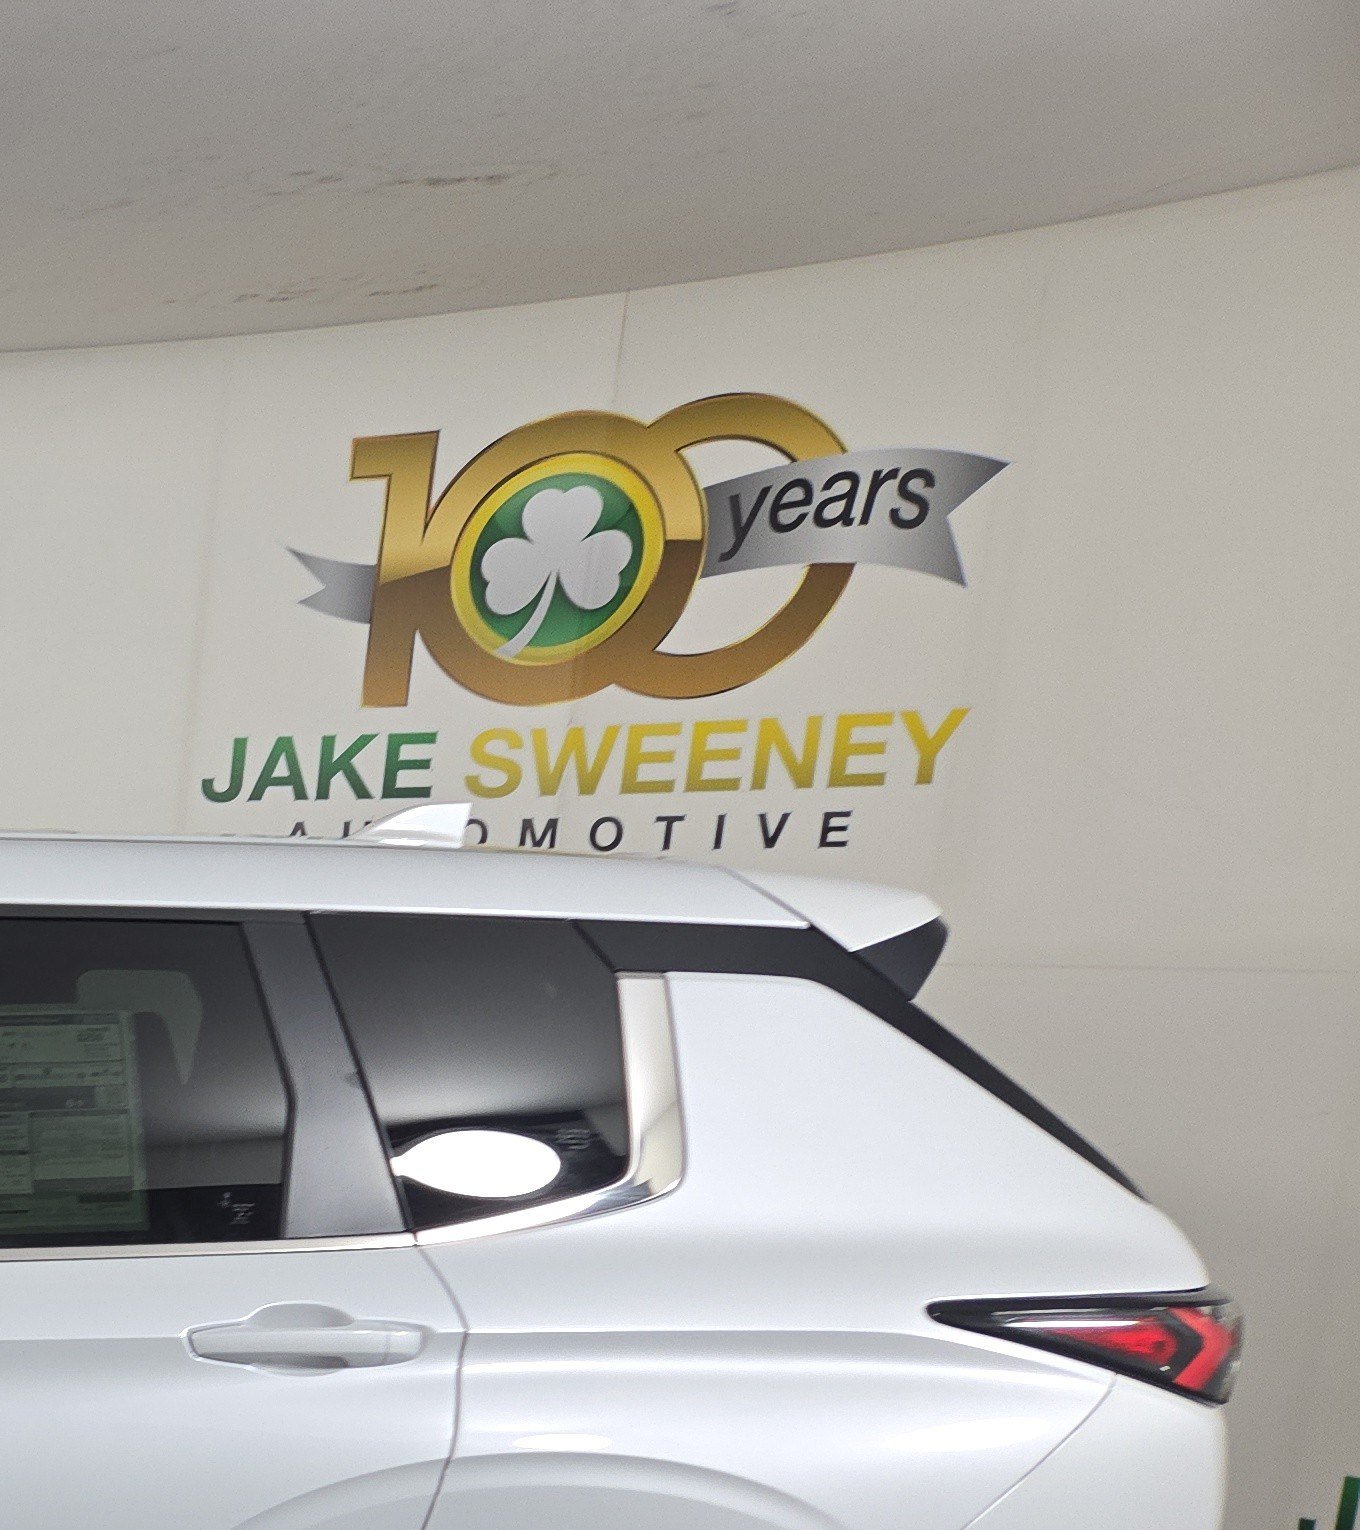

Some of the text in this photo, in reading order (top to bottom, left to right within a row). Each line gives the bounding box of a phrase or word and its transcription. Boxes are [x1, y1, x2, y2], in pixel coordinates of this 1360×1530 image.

[716, 463, 937, 562] years
[201, 706, 972, 802] JAKE SWEENEY
